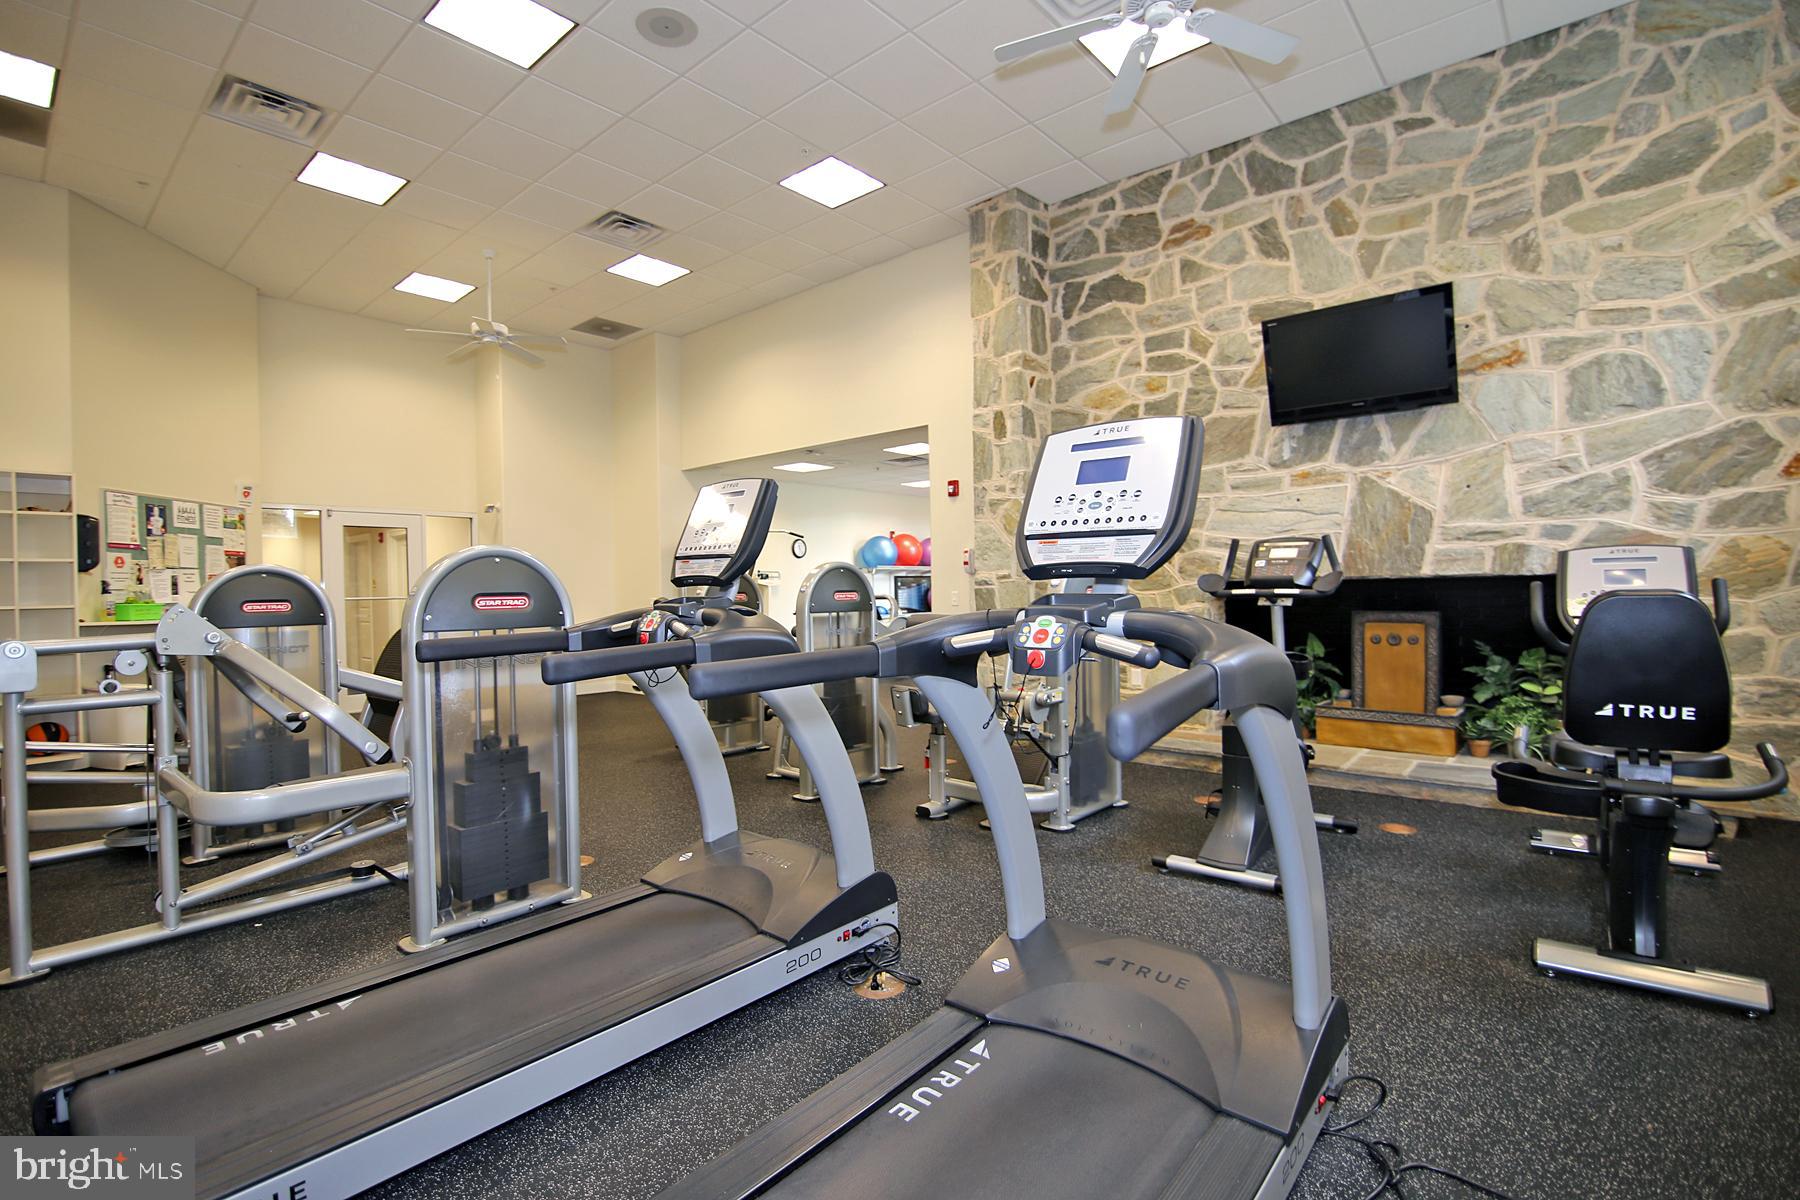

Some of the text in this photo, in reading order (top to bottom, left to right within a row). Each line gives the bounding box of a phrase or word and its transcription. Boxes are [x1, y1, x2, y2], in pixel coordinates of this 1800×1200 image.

[1102, 425, 1130, 435] TRUE
[1619, 704, 1697, 721] TRUE
[786, 948, 822, 974] 200
[1121, 959, 1191, 991] TRUE
[201, 1009, 331, 1056] TRUE
[888, 1058, 981, 1123] TRUE
[1282, 1132, 1305, 1184] 200
